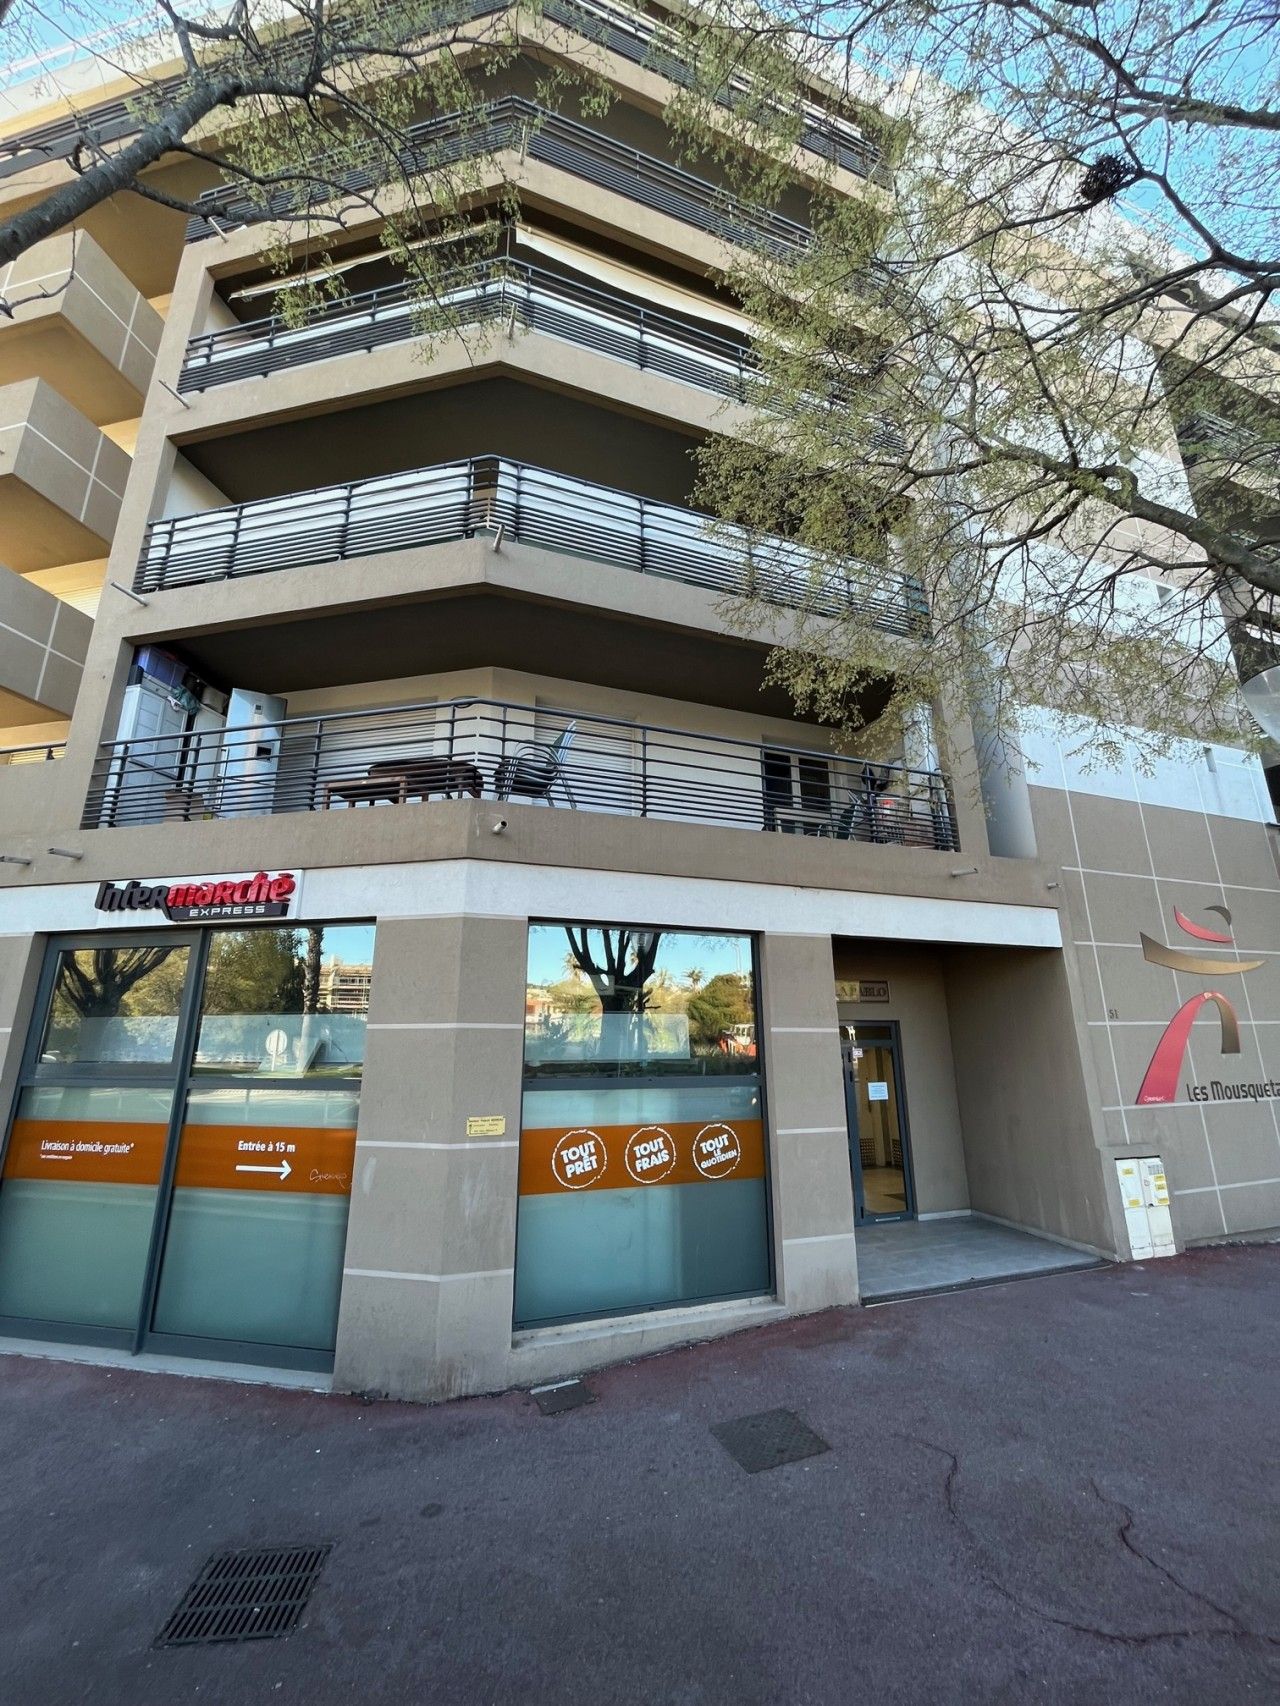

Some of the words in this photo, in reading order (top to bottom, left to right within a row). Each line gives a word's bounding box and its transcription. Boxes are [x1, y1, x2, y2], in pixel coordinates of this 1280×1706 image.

[189, 905, 265, 917] EXPRESS
[41, 1140, 69, 1151] Livraison
[70, 1140, 75, 1151] à
[76, 1141, 102, 1152] domicile
[238, 1141, 265, 1151] Entrée
[267, 1141, 273, 1152] à
[275, 1141, 285, 1152] 15
[287, 1144, 296, 1153] m
[560, 1140, 596, 1164] TOUT
[633, 1136, 665, 1158] TOUT
[700, 1133, 729, 1154] TOUT
[713, 1148, 721, 1157] LE
[565, 1155, 598, 1179] PRÊT
[635, 1149, 670, 1173] FRAIS
[700, 1149, 738, 1169] QUOTIDIEN
